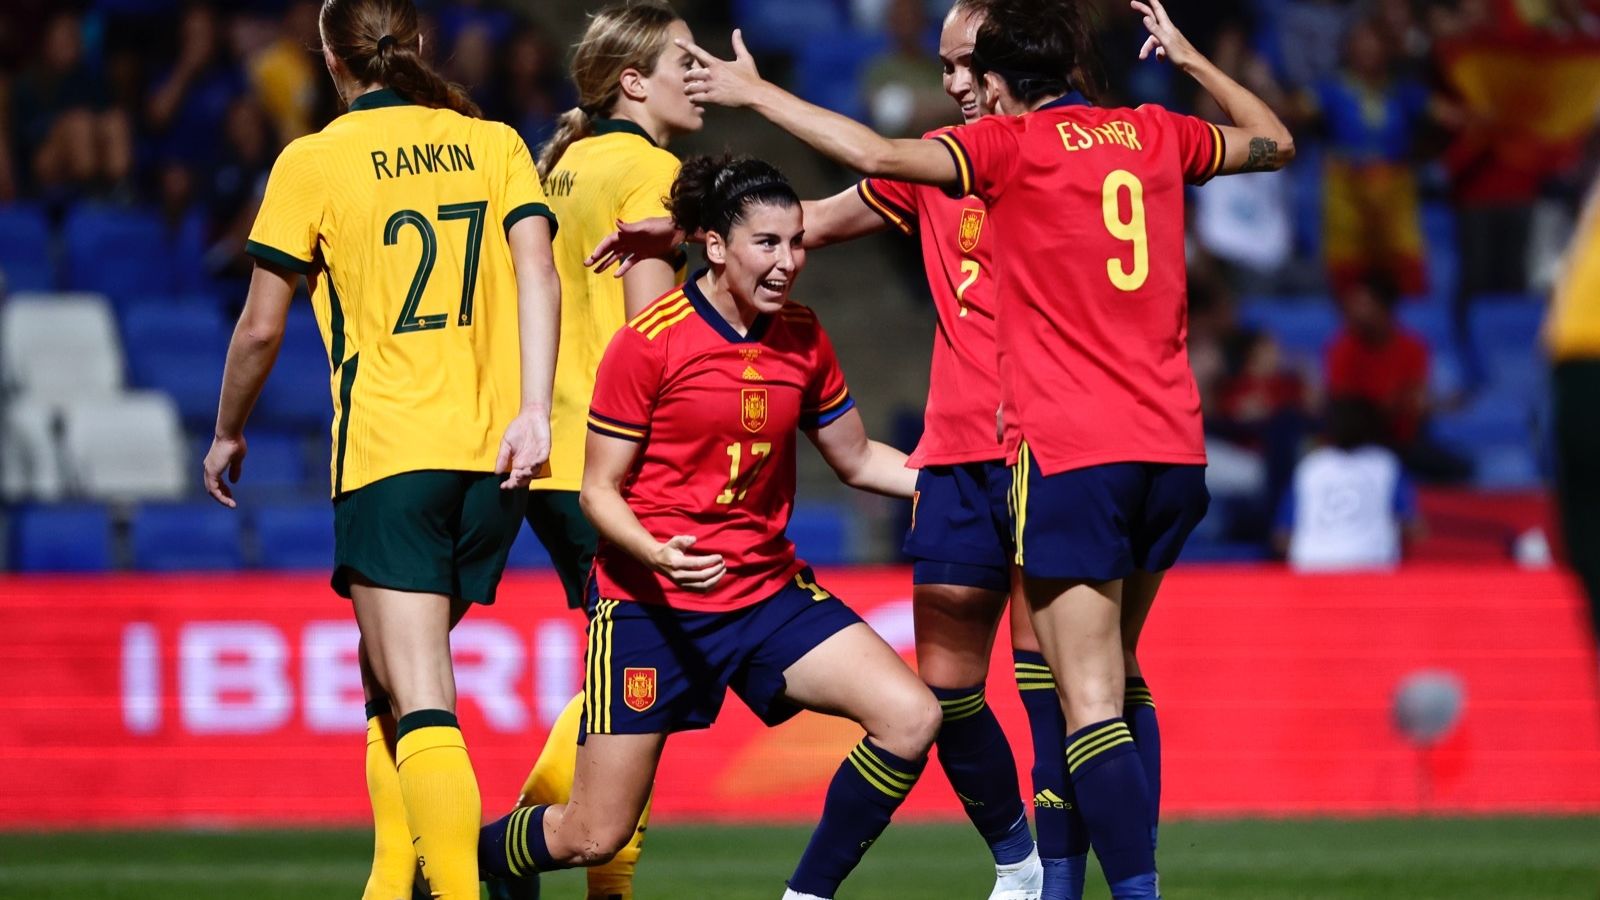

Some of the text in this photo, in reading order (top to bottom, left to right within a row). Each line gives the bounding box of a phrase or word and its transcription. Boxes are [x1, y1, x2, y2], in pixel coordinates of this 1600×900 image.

[371, 143, 475, 180] RANKIN
[1056, 120, 1142, 151] ESTHER
[1102, 169, 1149, 292] 9
[383, 200, 488, 335] 27
[957, 259, 980, 318] 7
[716, 442, 771, 504] 17
